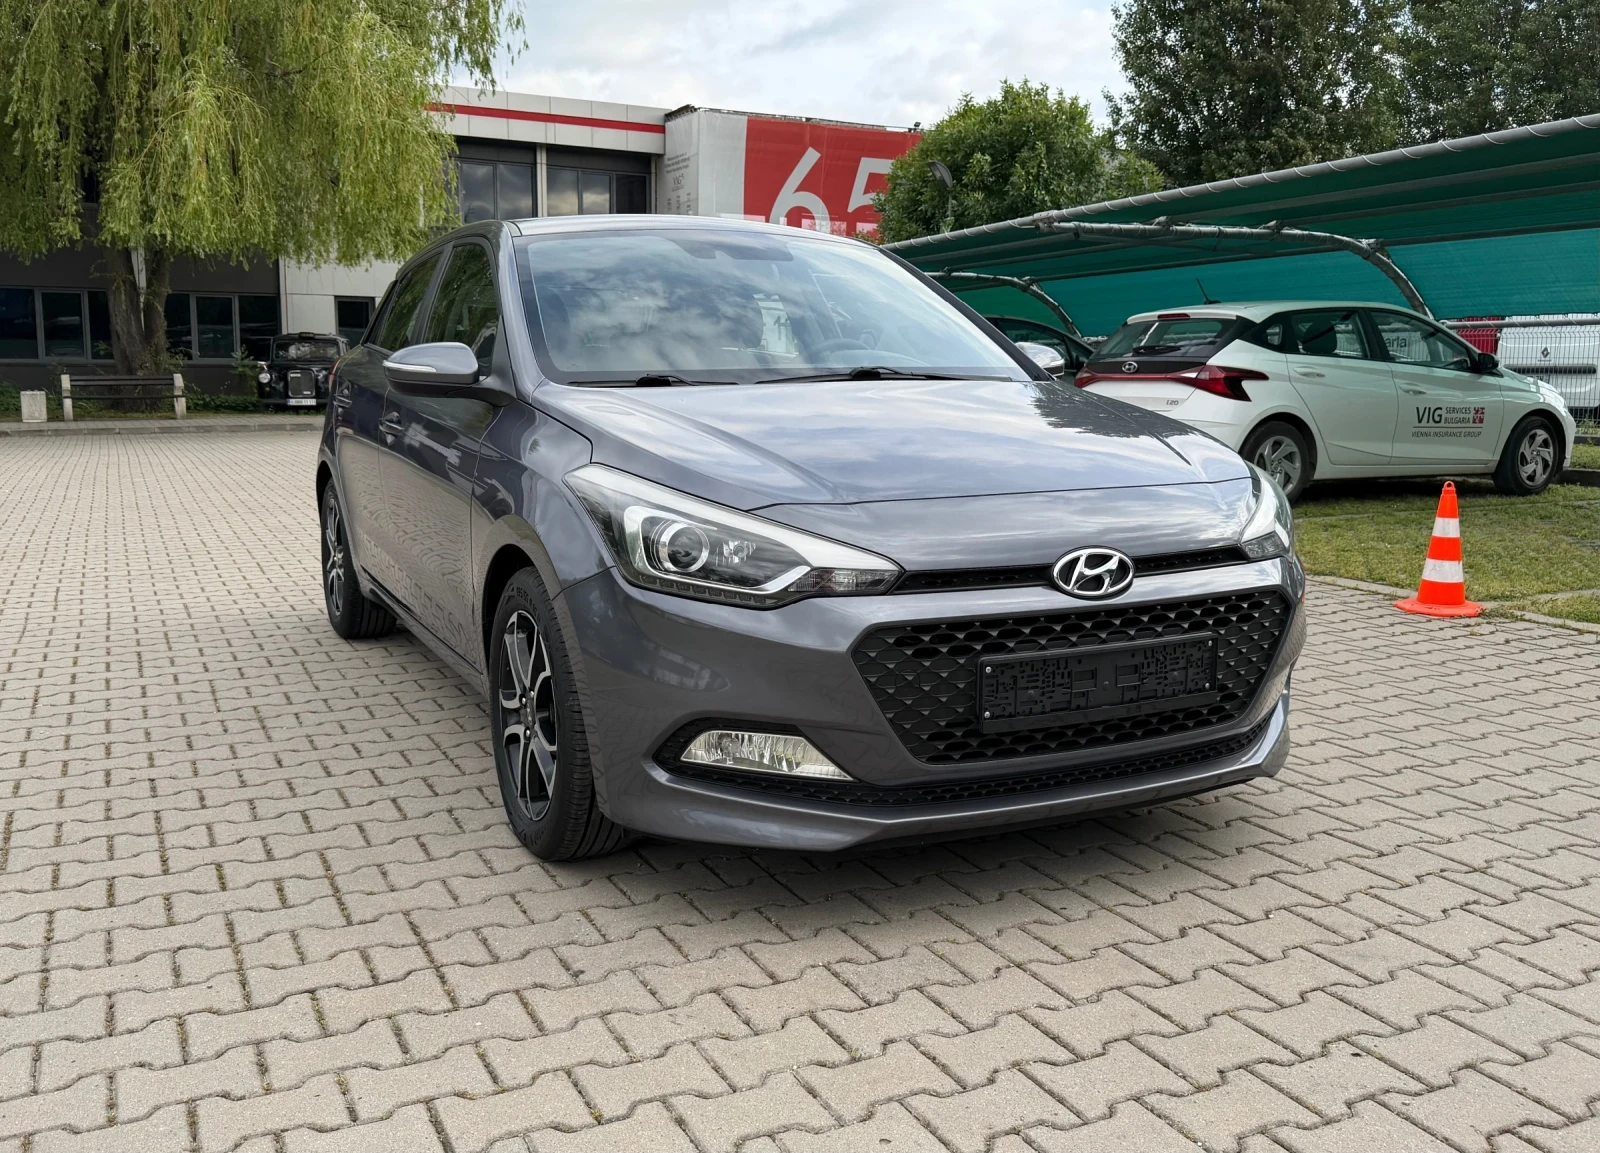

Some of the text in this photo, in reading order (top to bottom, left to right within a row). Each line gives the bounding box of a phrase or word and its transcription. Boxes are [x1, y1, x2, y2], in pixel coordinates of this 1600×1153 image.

[1416, 406, 1443, 424] VIG
[1445, 406, 1471, 415] SERVICES
[1444, 416, 1470, 424] BULGARIA
